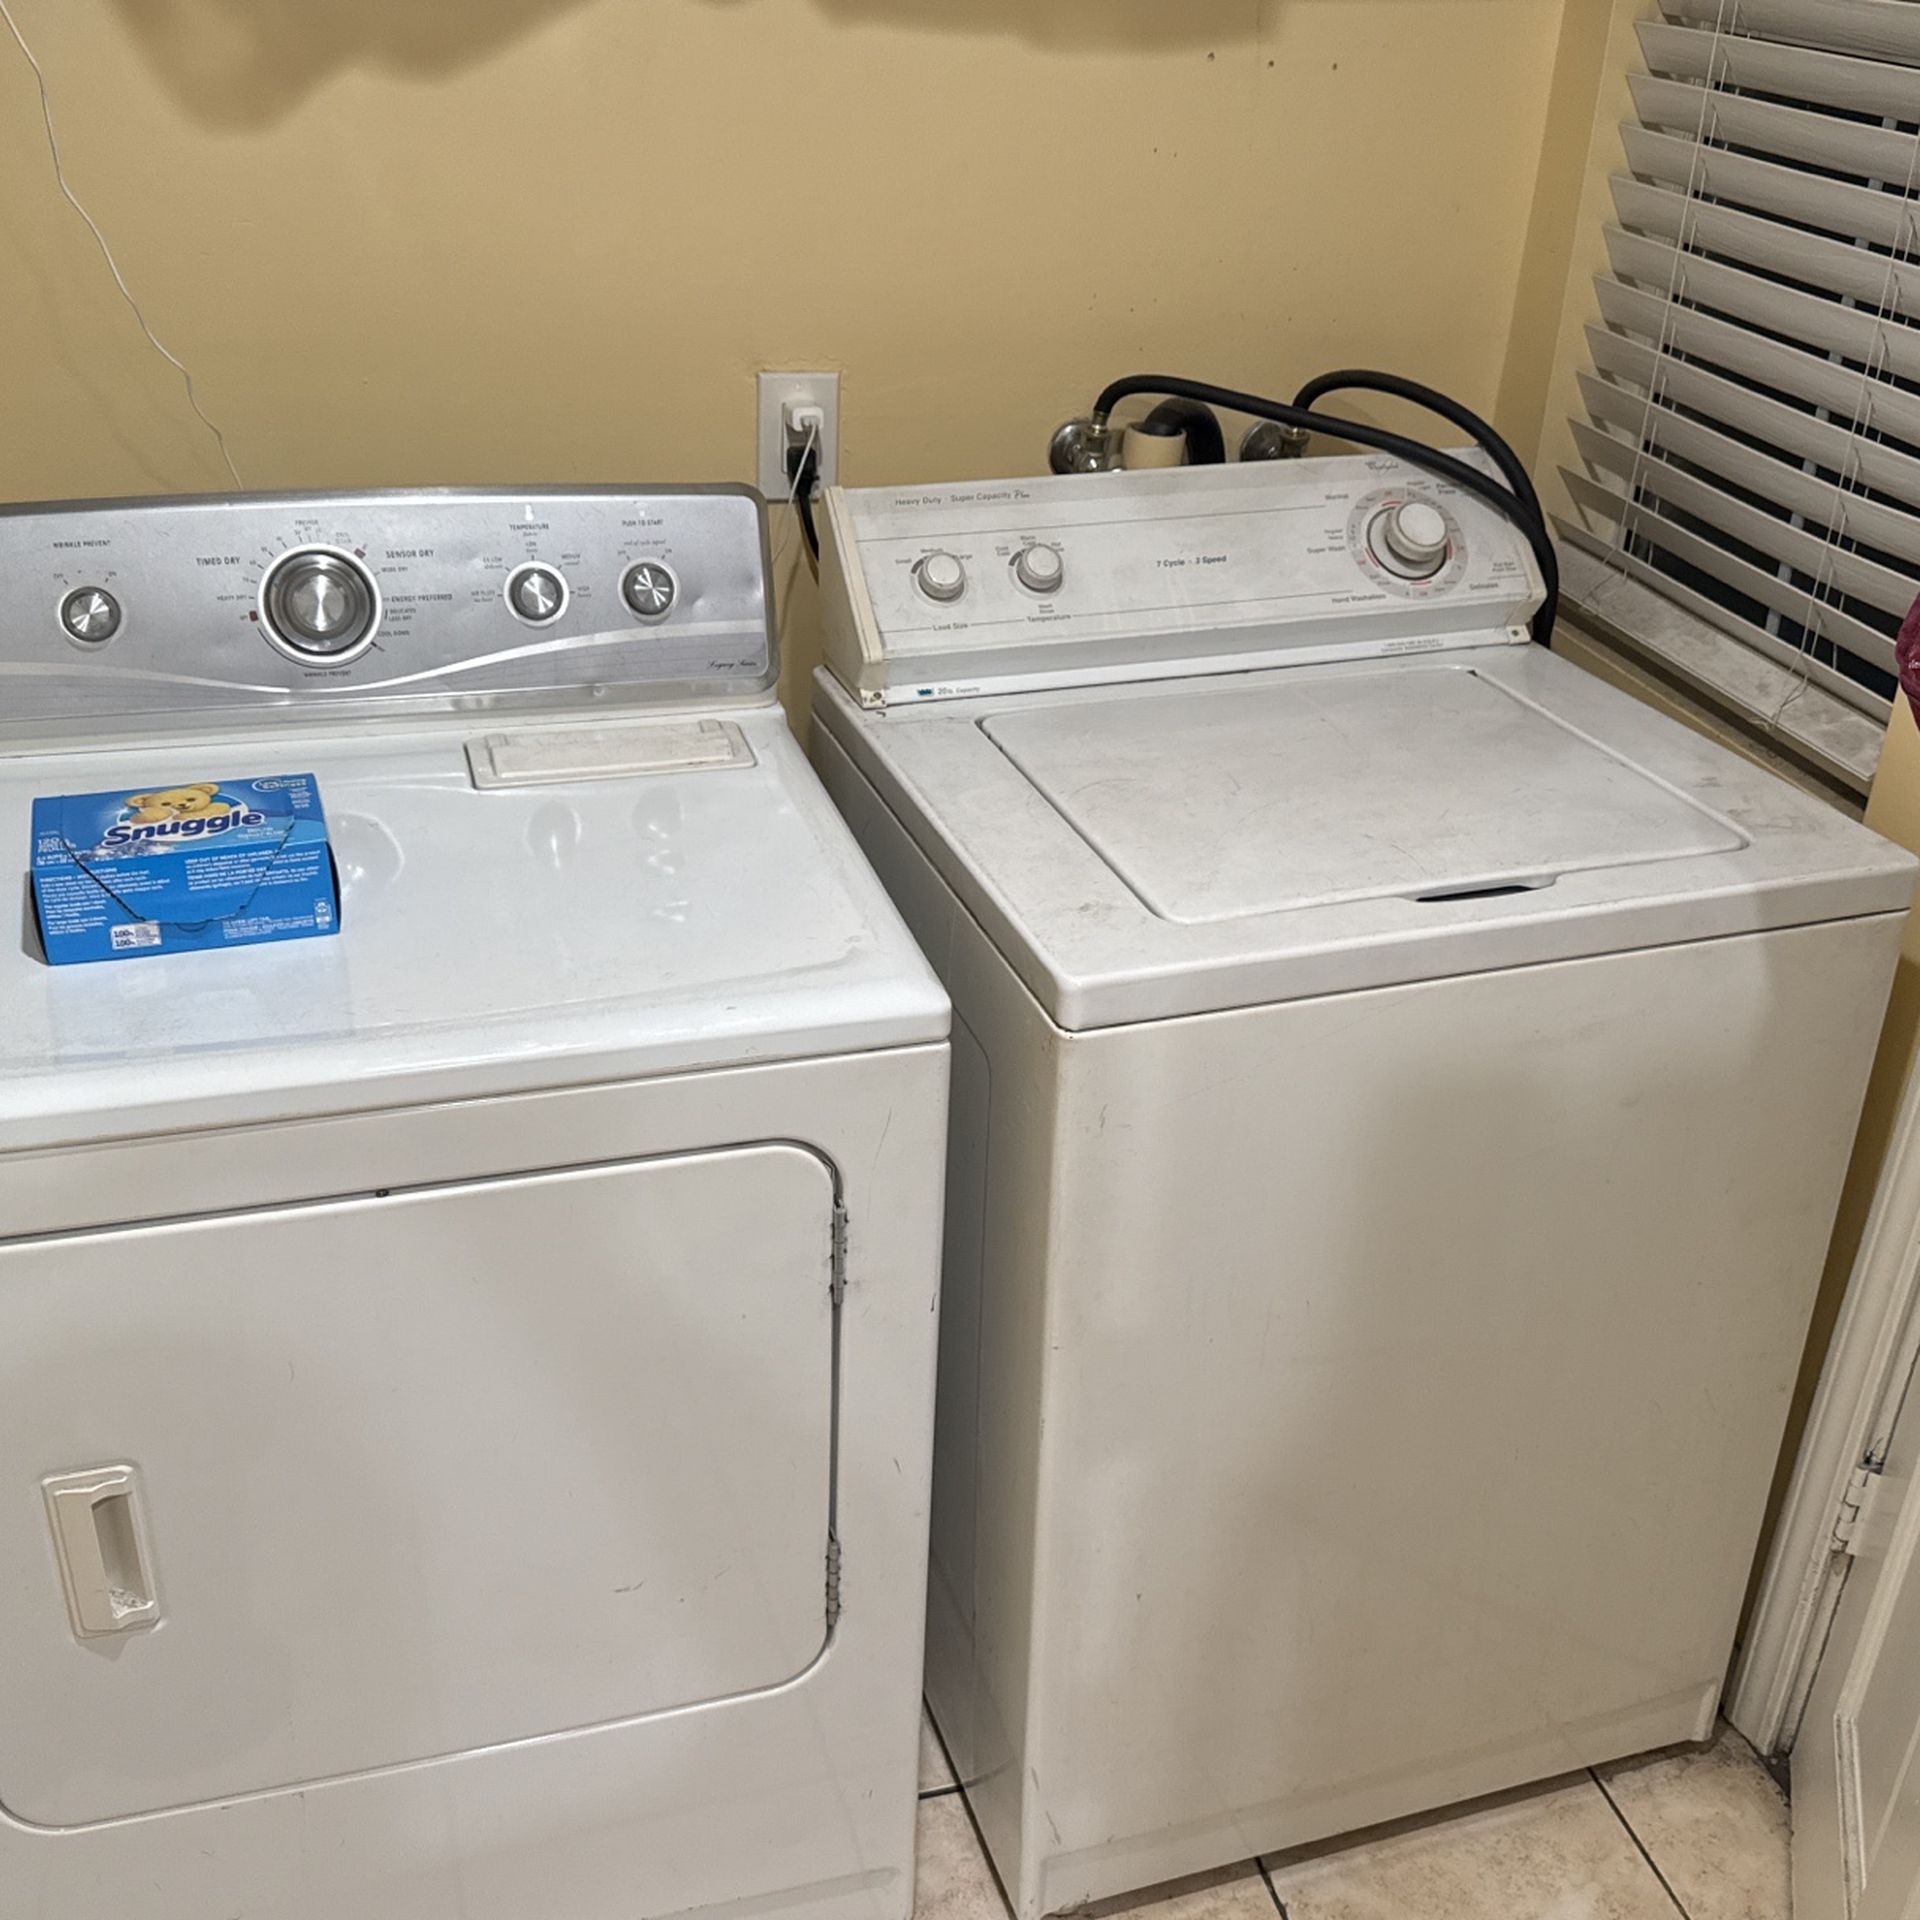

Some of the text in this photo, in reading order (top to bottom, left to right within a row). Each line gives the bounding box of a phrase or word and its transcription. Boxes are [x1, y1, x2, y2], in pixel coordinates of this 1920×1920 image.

[922, 496, 942, 504] Duty
[950, 494, 974, 503] Super
[976, 491, 1012, 501] Capacity
[509, 523, 550, 531] TEMPERATURE
[82, 539, 111, 547] PREVENT
[385, 549, 434, 559] SENSOR DRY
[196, 556, 240, 566] TIMED DRY
[1163, 559, 1185, 568] Cycle
[1202, 555, 1227, 564] Speed
[418, 593, 453, 601] PREFERRED
[1026, 614, 1072, 624] Temperature
[933, 623, 969, 632] Load Size
[106, 810, 263, 846] Snuggle
